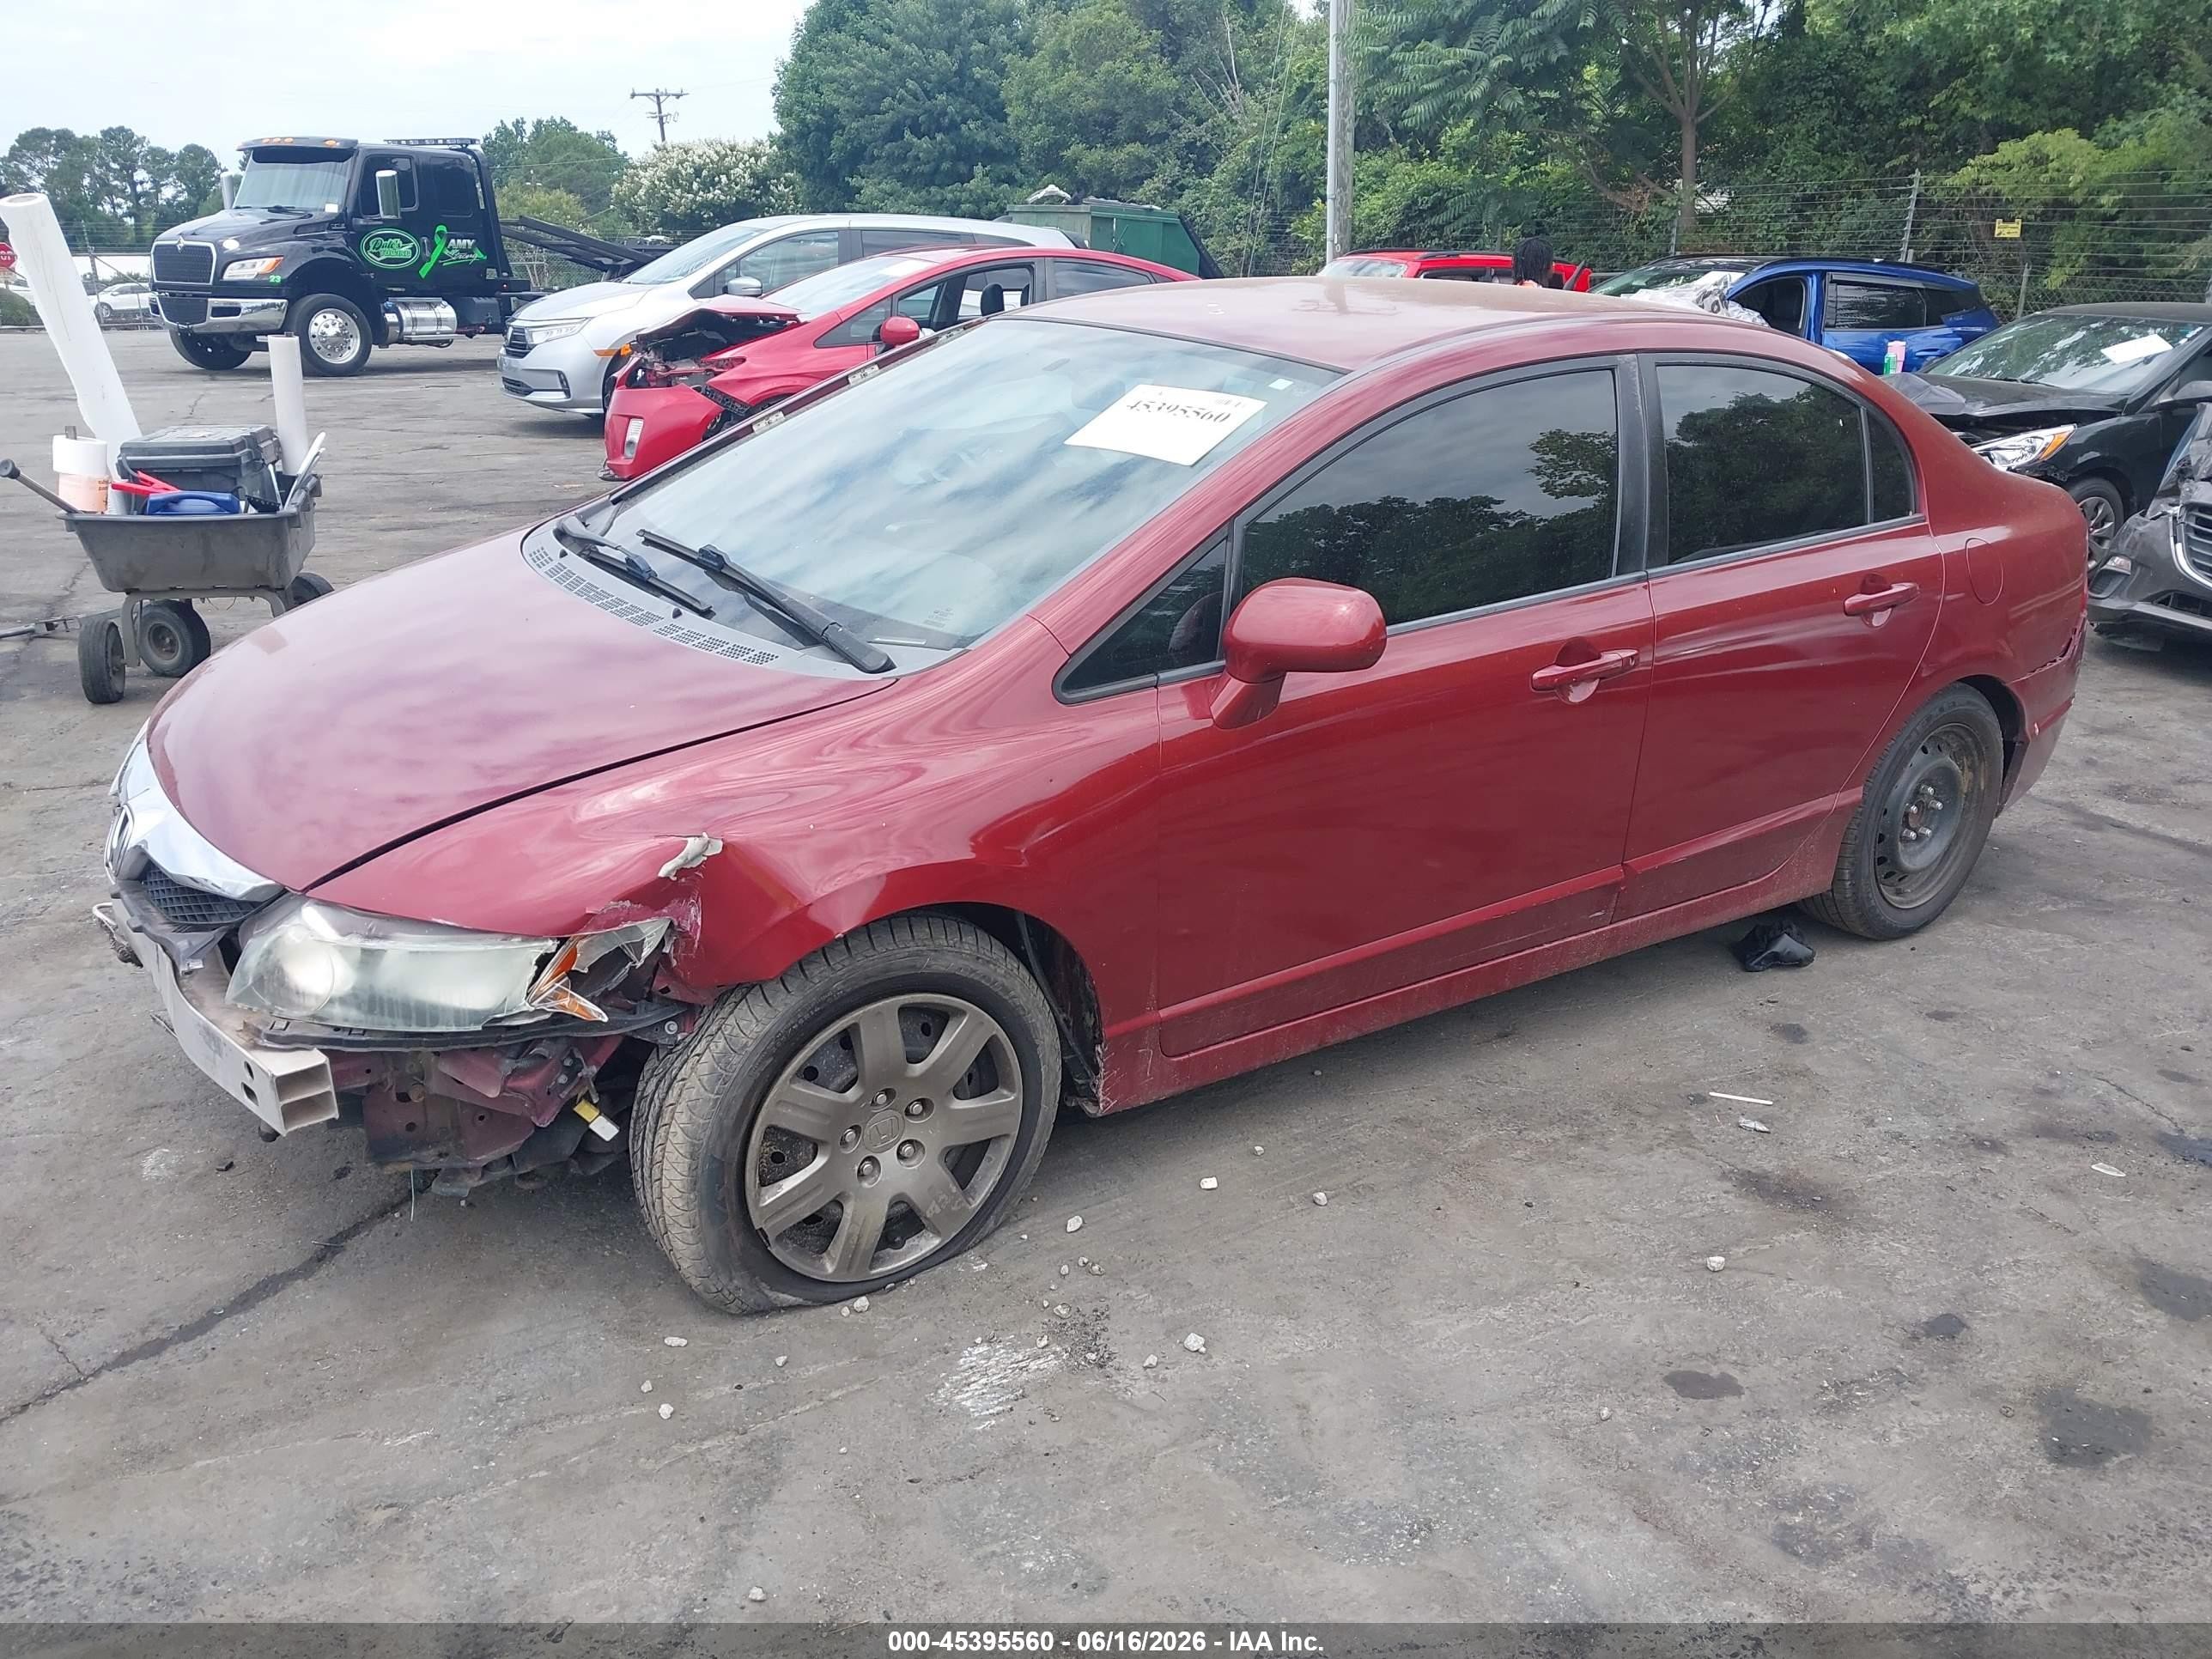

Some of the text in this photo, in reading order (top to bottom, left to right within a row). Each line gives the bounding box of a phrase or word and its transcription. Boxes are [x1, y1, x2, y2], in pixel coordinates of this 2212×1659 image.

[447, 238, 475, 249] AMY
[0, 250, 12, 261] OP
[269, 275, 282, 283] 23
[1126, 400, 1232, 422] 45395560
